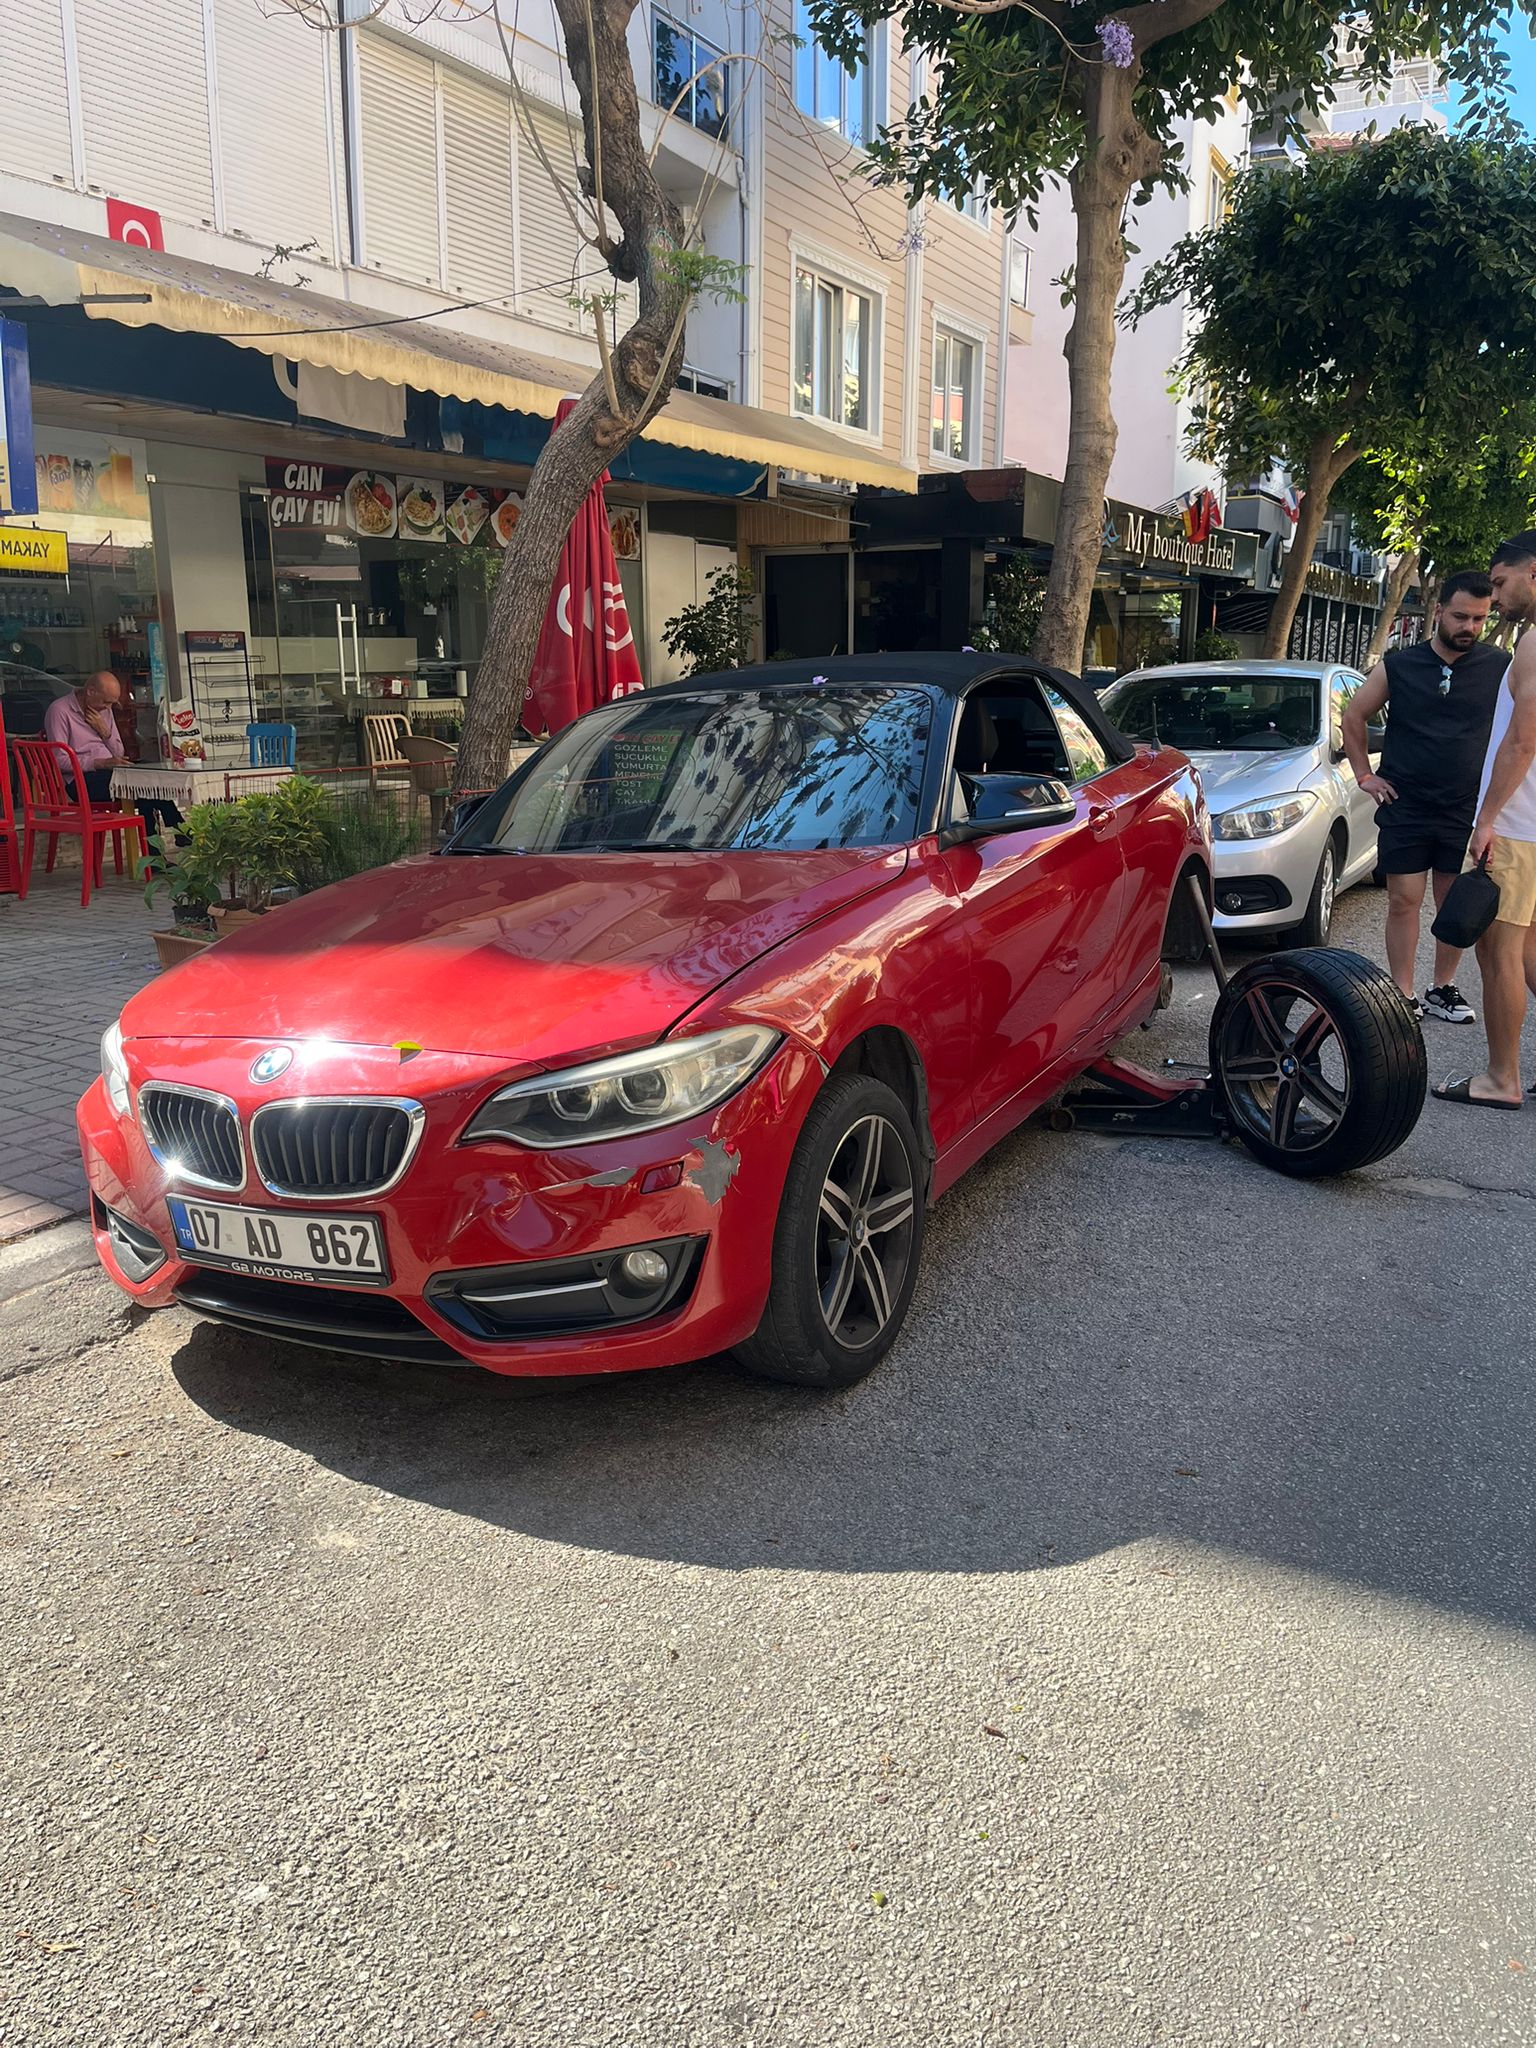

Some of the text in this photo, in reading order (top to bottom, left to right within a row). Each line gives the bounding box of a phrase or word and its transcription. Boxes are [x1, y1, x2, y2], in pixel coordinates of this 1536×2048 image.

[284, 463, 323, 492] CAN
[271, 495, 308, 527] ÇAY
[1125, 512, 1236, 576] My boutique Hotel
[180, 1228, 193, 1240] TR
[189, 1208, 376, 1268] 07 AD 862
[252, 1264, 315, 1282] MOTORS
